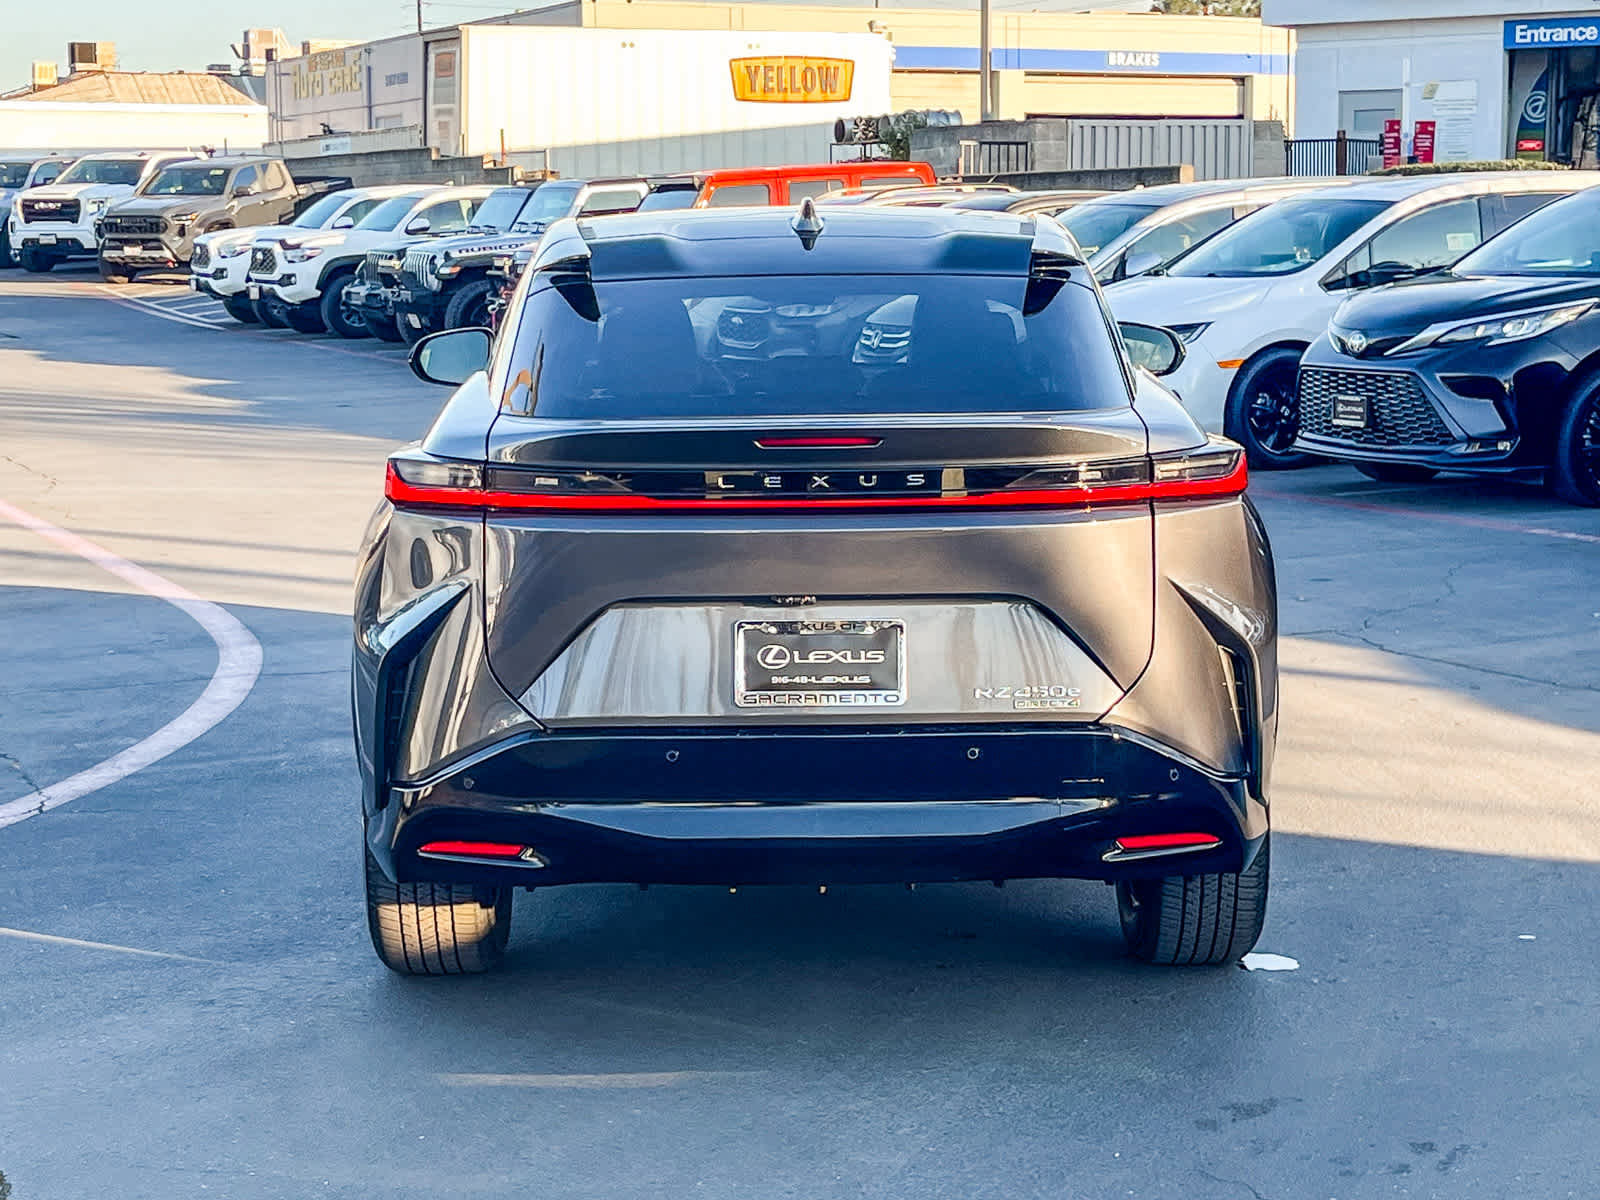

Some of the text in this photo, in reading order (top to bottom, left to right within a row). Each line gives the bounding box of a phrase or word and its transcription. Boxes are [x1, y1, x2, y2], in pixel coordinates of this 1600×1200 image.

[1515, 23, 1599, 43] Entrance
[1107, 51, 1161, 66] BRAKES
[744, 65, 840, 95] YELLOW
[717, 473, 925, 489] LEXUS
[793, 650, 886, 664] LEXUS
[743, 693, 901, 705] SACRAMENTO
